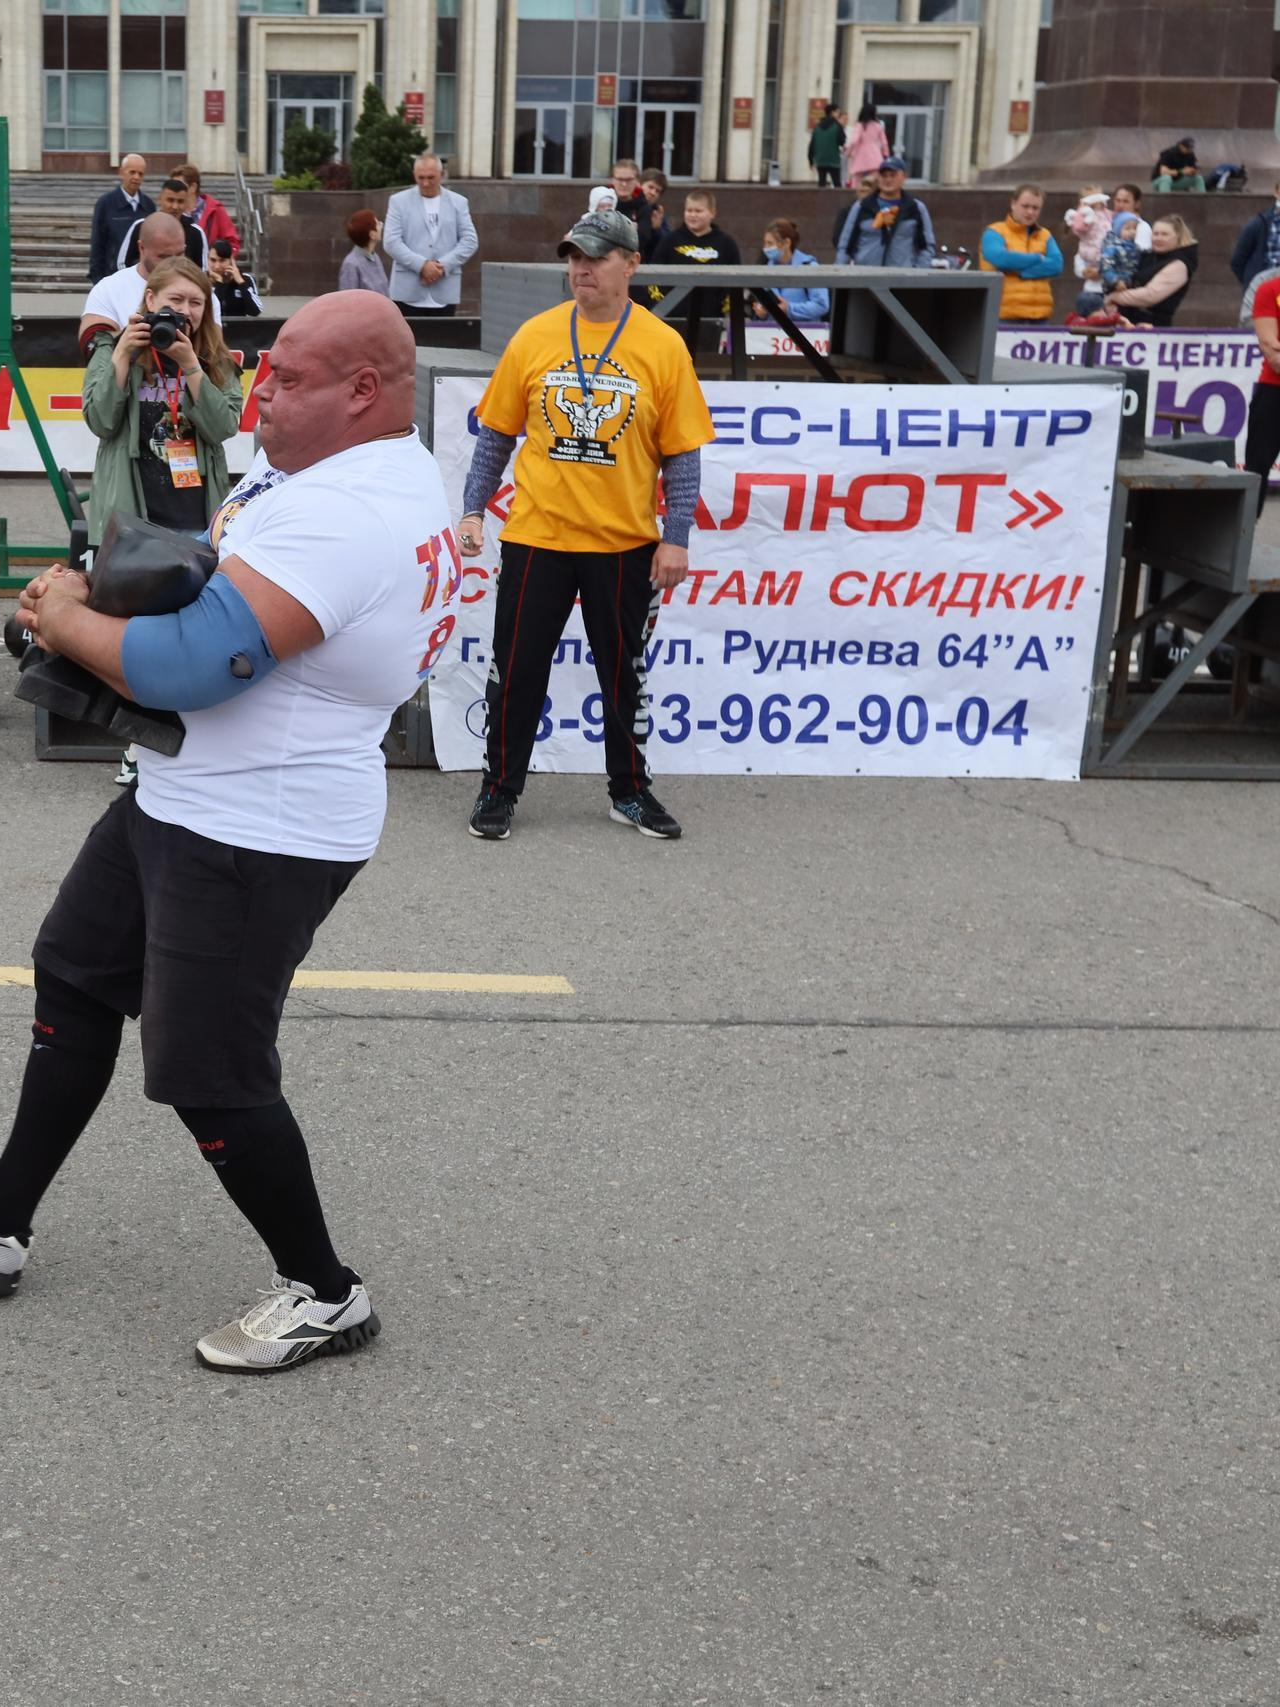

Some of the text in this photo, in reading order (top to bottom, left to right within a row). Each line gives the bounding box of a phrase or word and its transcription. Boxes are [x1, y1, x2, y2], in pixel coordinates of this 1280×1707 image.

[1157, 342, 1261, 371] ЦЕНТР
[829, 571, 1085, 618] СКИДКИ!
[461, 636, 485, 663] г.
[722, 629, 920, 675] Руднева
